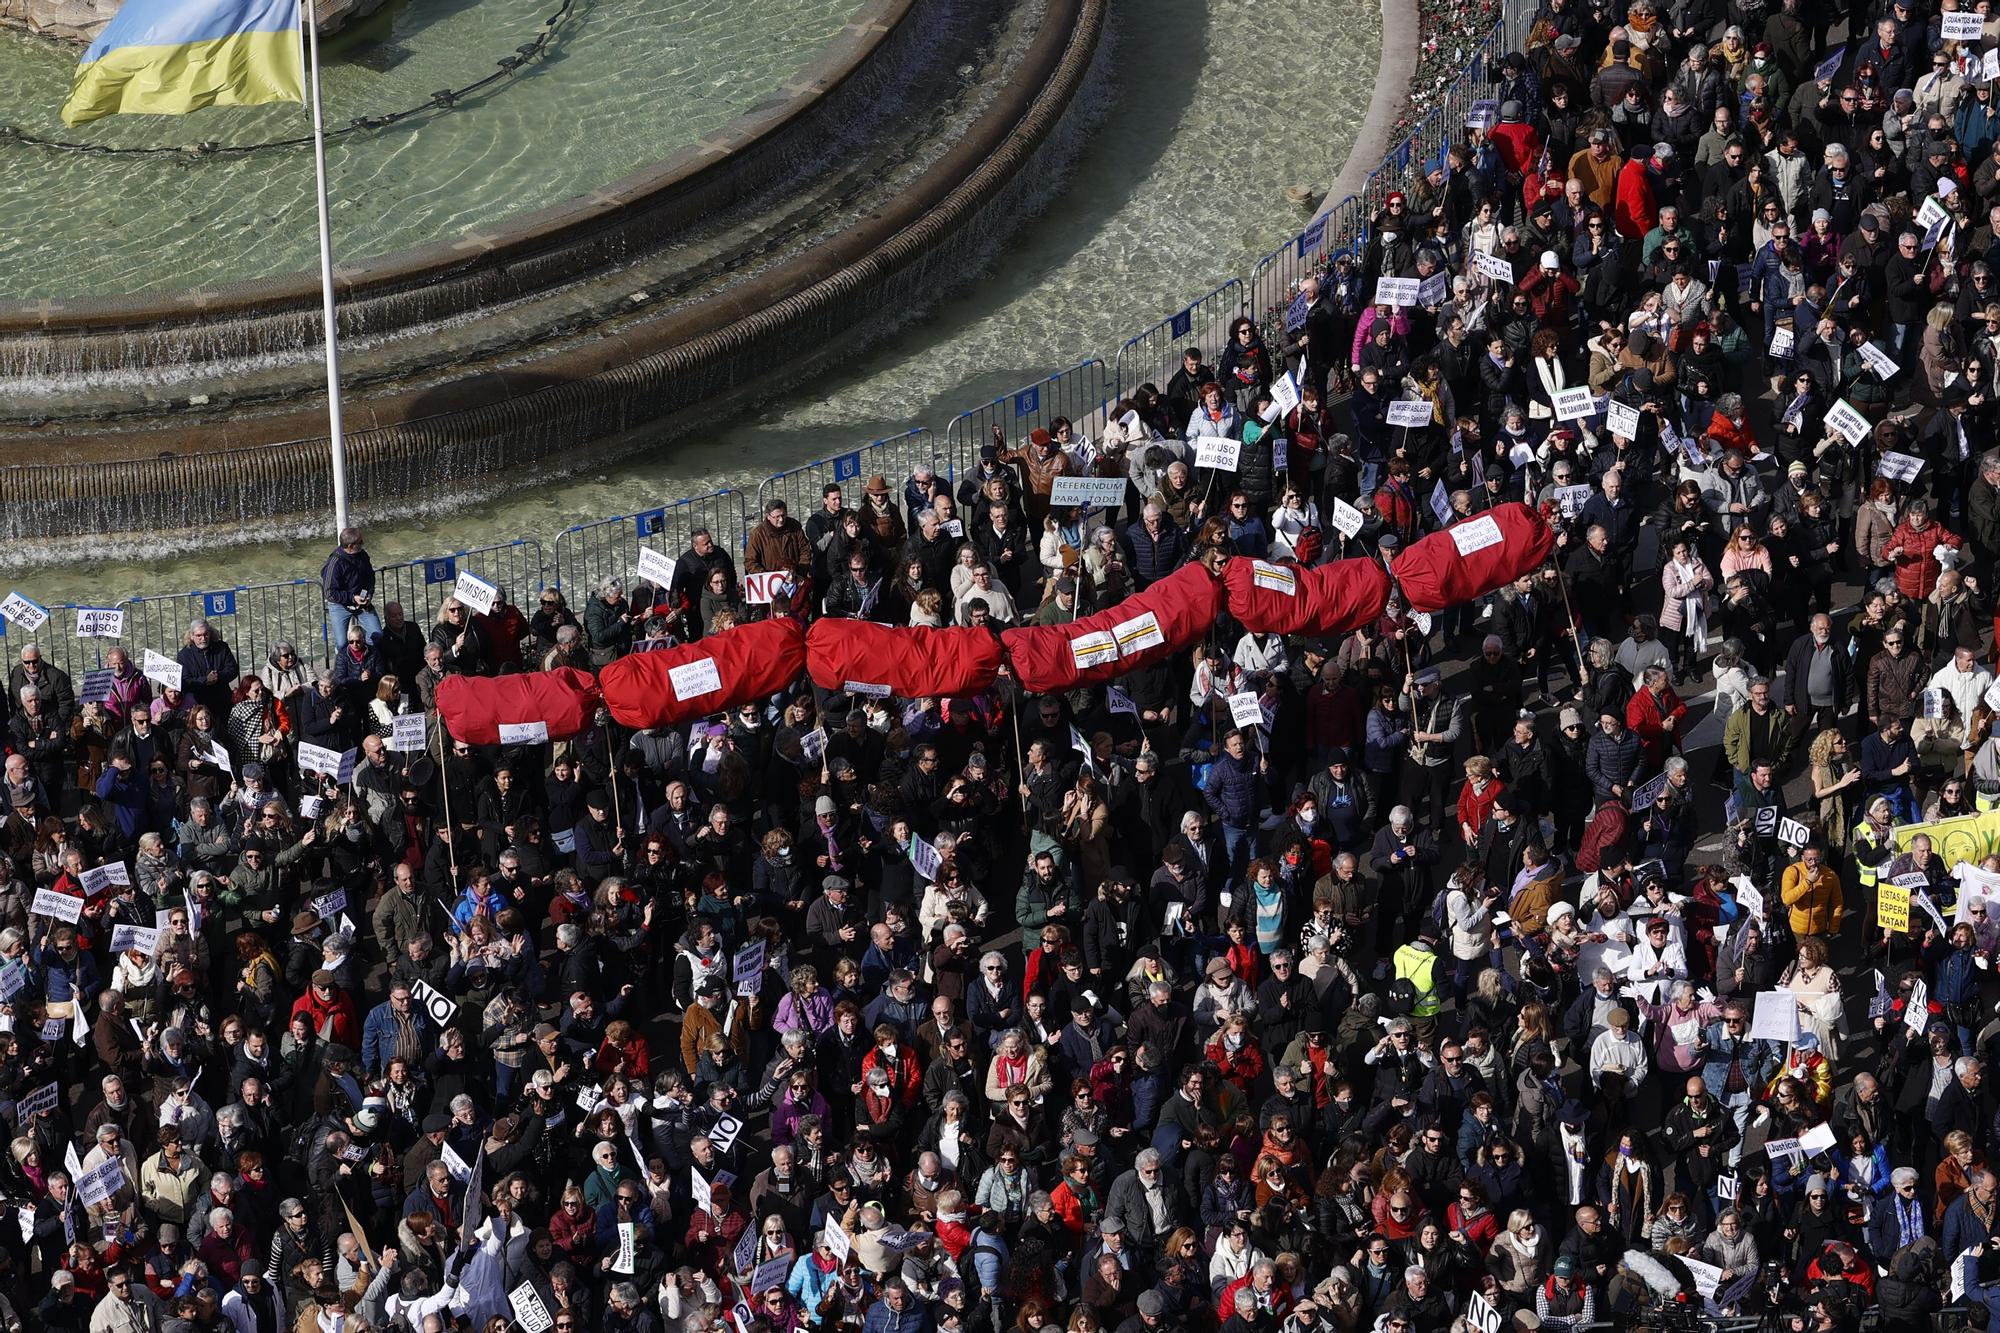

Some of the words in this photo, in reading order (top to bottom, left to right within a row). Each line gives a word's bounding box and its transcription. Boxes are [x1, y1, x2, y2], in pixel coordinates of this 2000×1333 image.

[1619, 404, 1639, 422] VENDE
[1056, 481, 1123, 490] REFERENDUM
[1054, 495, 1079, 504] PARA
[1781, 820, 1808, 846] NO
[1880, 891, 1900, 900] LISTAS
[1880, 903, 1907, 916] ESPERA
[710, 1116, 737, 1150] NO
[1768, 1140, 1801, 1152] ¡Justicia!
[519, 1303, 541, 1333] SALUD
[531, 1296, 551, 1328] VENDE
[1469, 1294, 1499, 1333] NO
